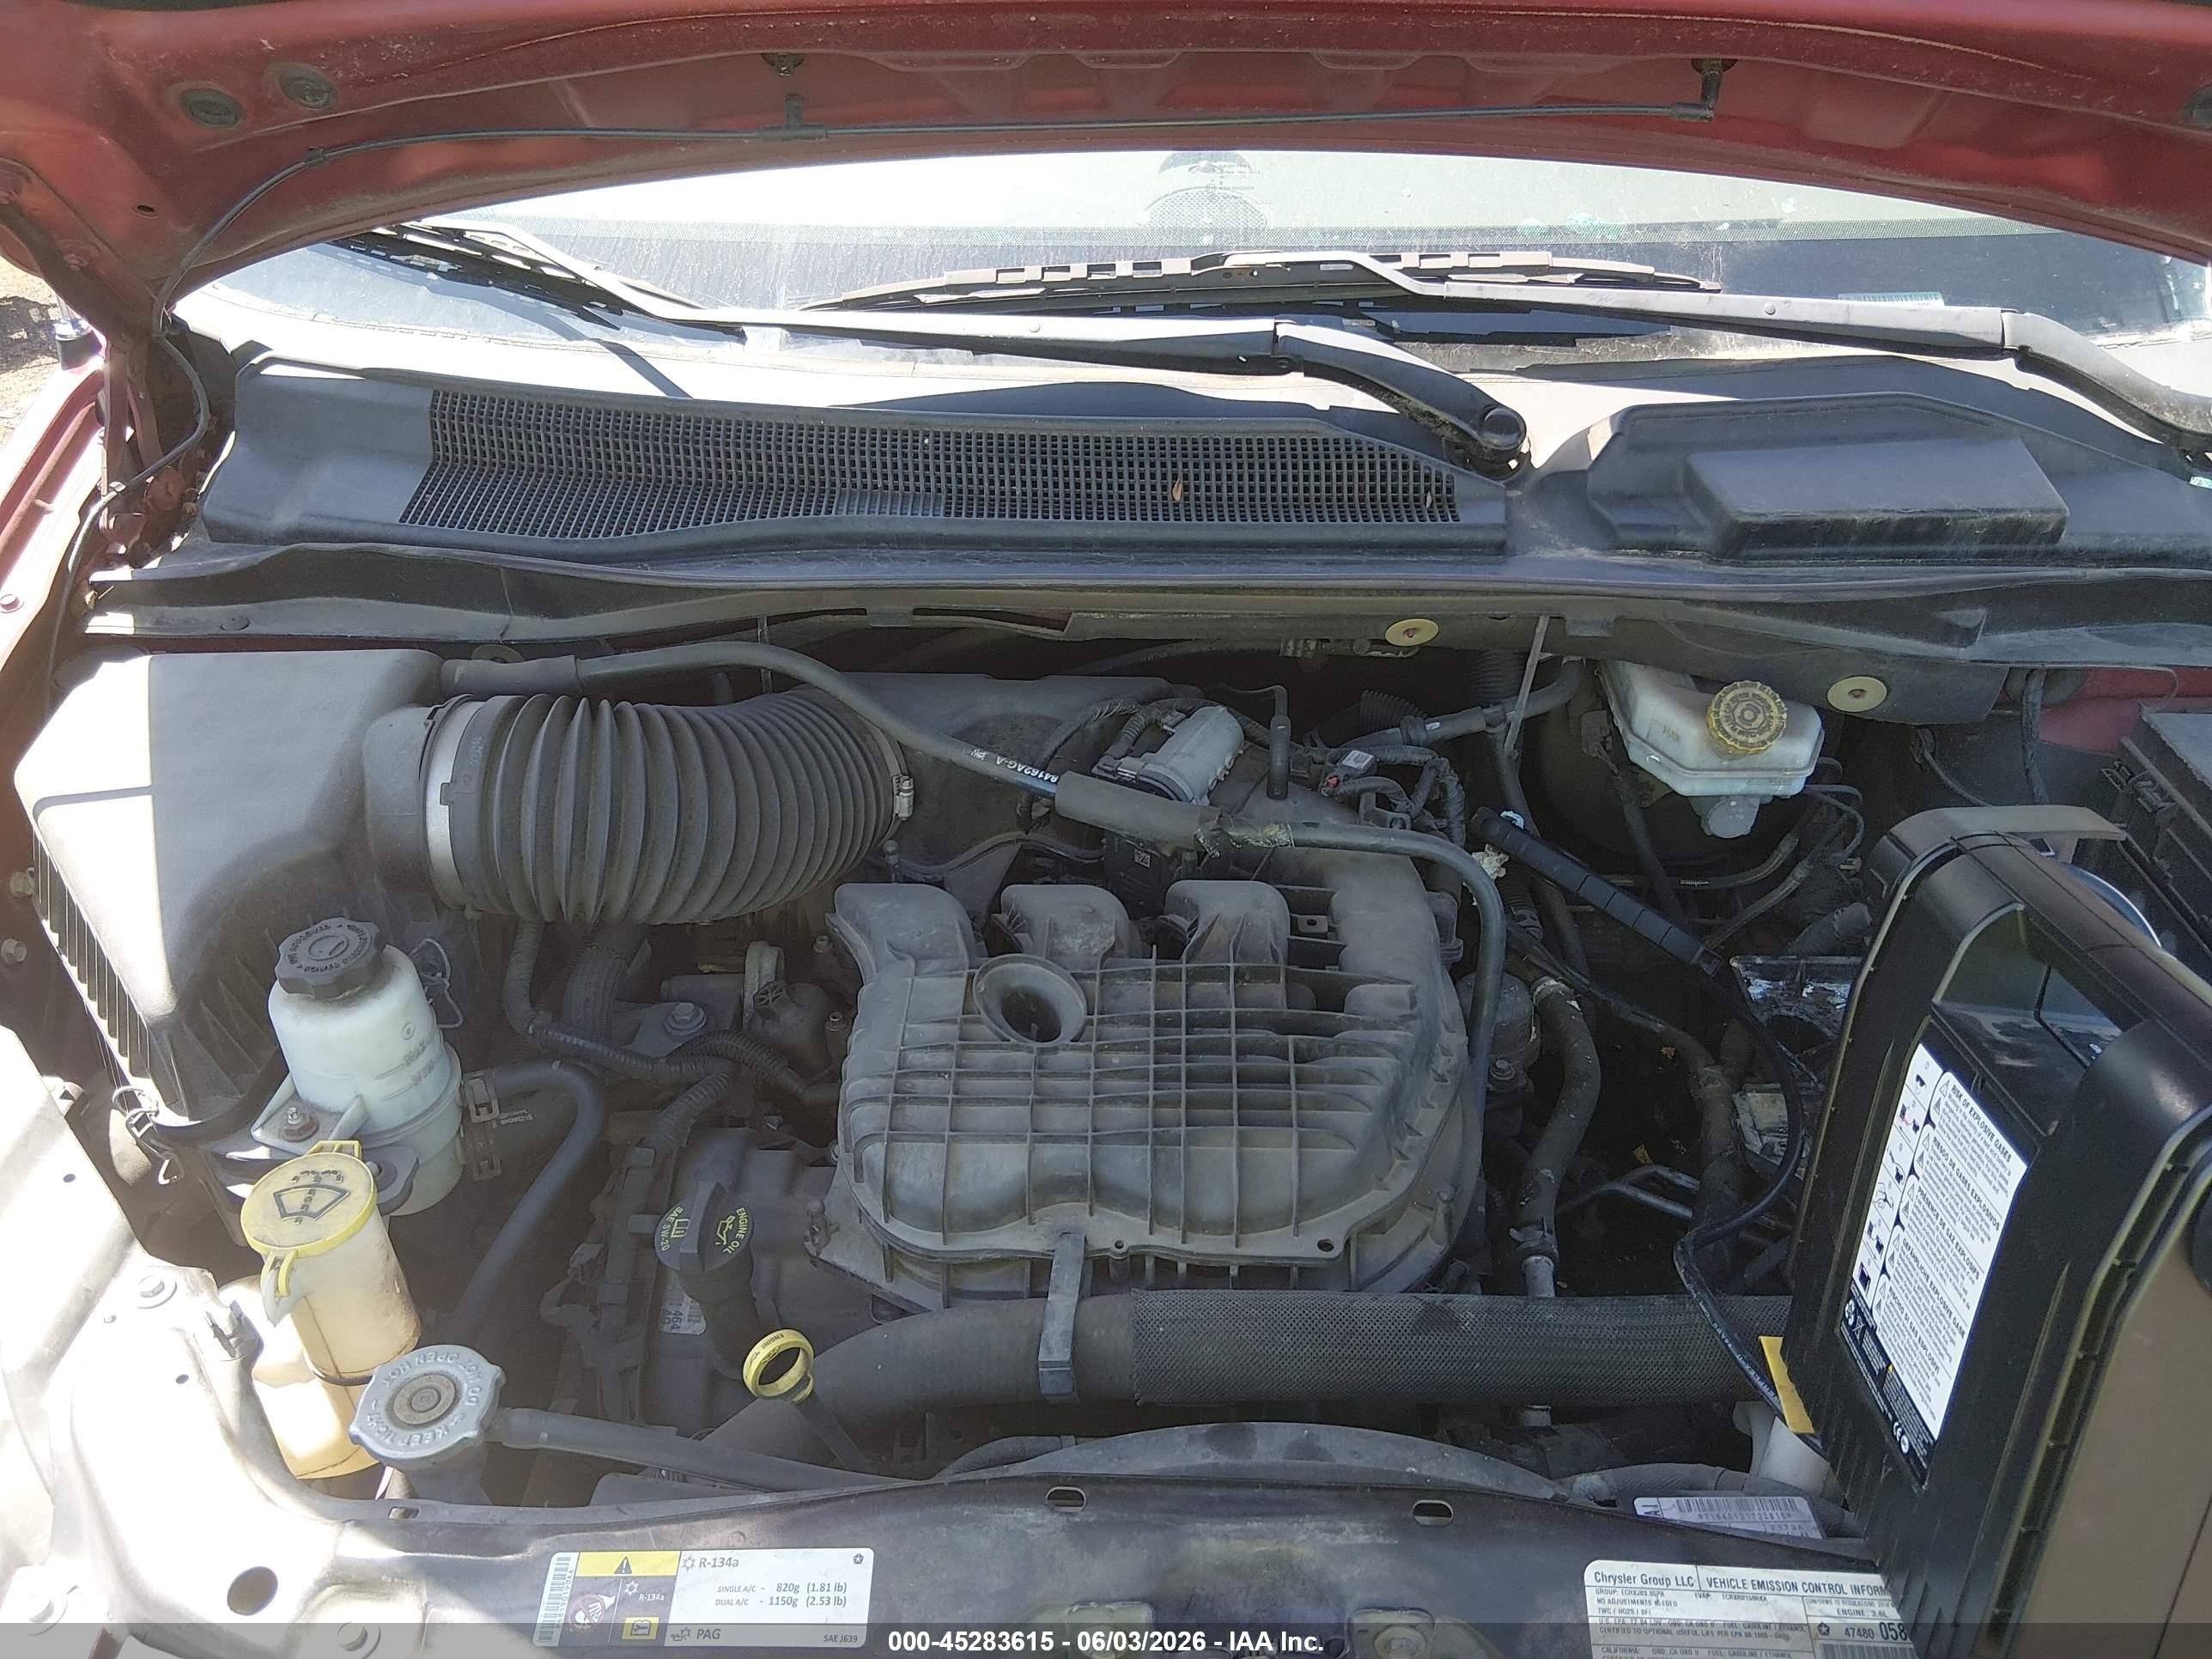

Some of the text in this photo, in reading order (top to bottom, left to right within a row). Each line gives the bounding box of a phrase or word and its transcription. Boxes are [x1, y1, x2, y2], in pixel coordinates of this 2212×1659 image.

[1951, 1085, 2012, 1163] RISK OF EXPLOSIVE GASES
[1948, 1158, 1956, 1171] DE
[1956, 1168, 1971, 1192] GASES
[1971, 1188, 2000, 1231] EXPLOSIVOS
[660, 1206, 684, 1251] SAE 5W-20
[723, 1207, 750, 1254] ENGINE OIL
[415, 1352, 459, 1366] OPEN
[380, 1359, 411, 1388] HOT
[399, 1426, 449, 1447] KEEP
[698, 1557, 738, 1568] R-134a
[1594, 1571, 1694, 1588] Chrysler Group LLC
[1705, 1577, 1747, 1589] VEHICLE
[1751, 1578, 1799, 1593] EMISSION
[1802, 1581, 1848, 1595] CONTROL
[743, 1584, 757, 1593] A/C
[776, 1583, 799, 1595] 820g
[806, 1582, 831, 1594] (1.81
[833, 1582, 848, 1594] lb)
[639, 1593, 665, 1601] R-134a
[734, 1598, 750, 1607] A/C
[769, 1595, 799, 1608] 1150g
[806, 1595, 831, 1607] (2.53
[833, 1595, 847, 1607] lb)
[1607, 1597, 1652, 1606] ADJUSTMENTS
[696, 1628, 721, 1641] PAG
[823, 1634, 858, 1644] SAE J639
[1643, 1627, 1674, 1636] OPTIONAL
[1844, 1622, 1908, 1642] 47480 058
